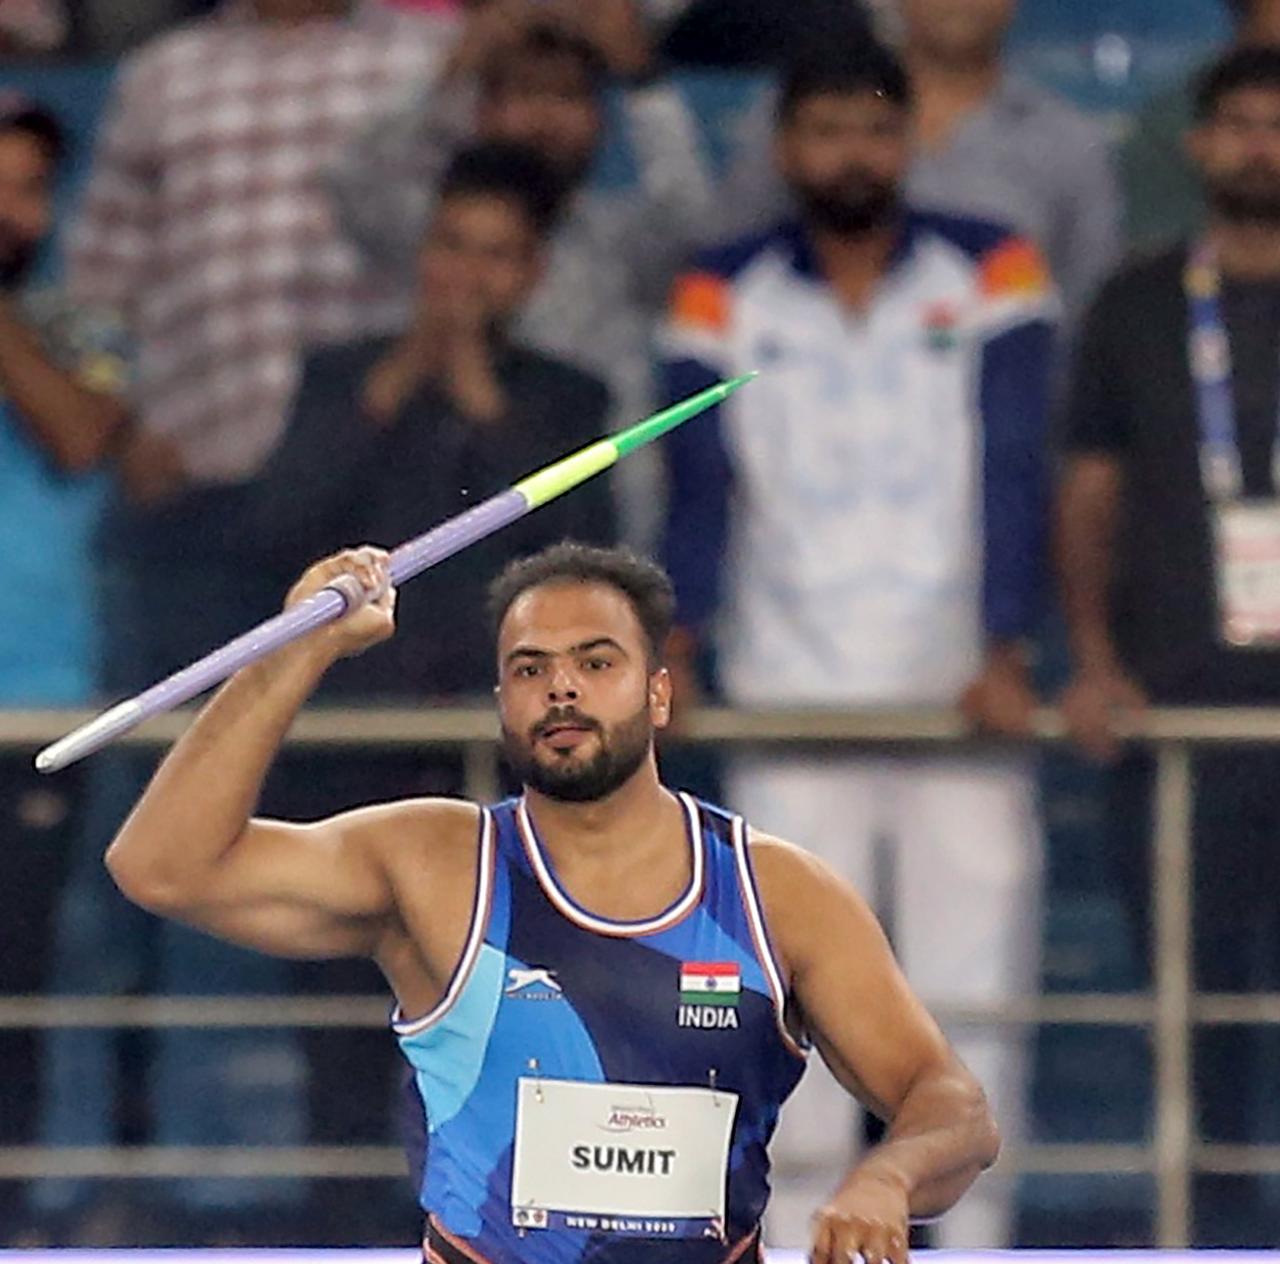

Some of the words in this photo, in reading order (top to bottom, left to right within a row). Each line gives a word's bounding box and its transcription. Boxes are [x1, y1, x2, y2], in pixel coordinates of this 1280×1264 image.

[679, 1005, 738, 1029] INDIA
[572, 1145, 676, 1175] SUMIT
[566, 1216, 597, 1229] NEW
